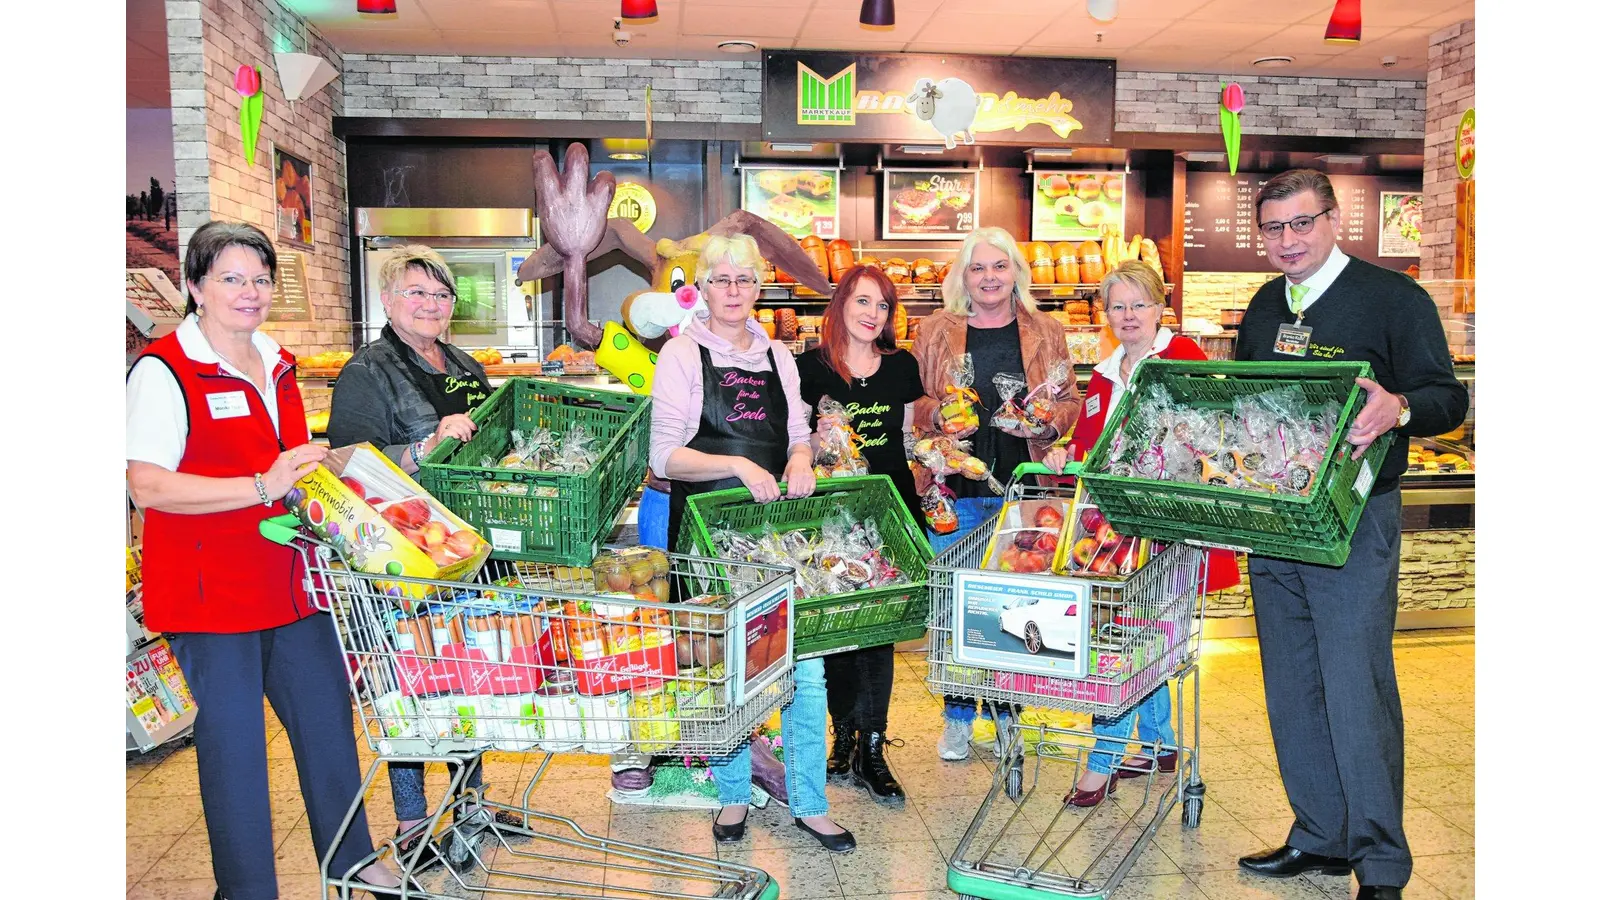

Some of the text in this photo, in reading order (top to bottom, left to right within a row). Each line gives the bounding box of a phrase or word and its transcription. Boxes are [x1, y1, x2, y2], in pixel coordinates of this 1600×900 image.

[719, 371, 767, 387] Backen
[736, 389, 761, 401] für die
[726, 402, 767, 422] Seele
[845, 401, 891, 416] Backen
[856, 418, 883, 433] für die
[856, 432, 888, 450] Seele
